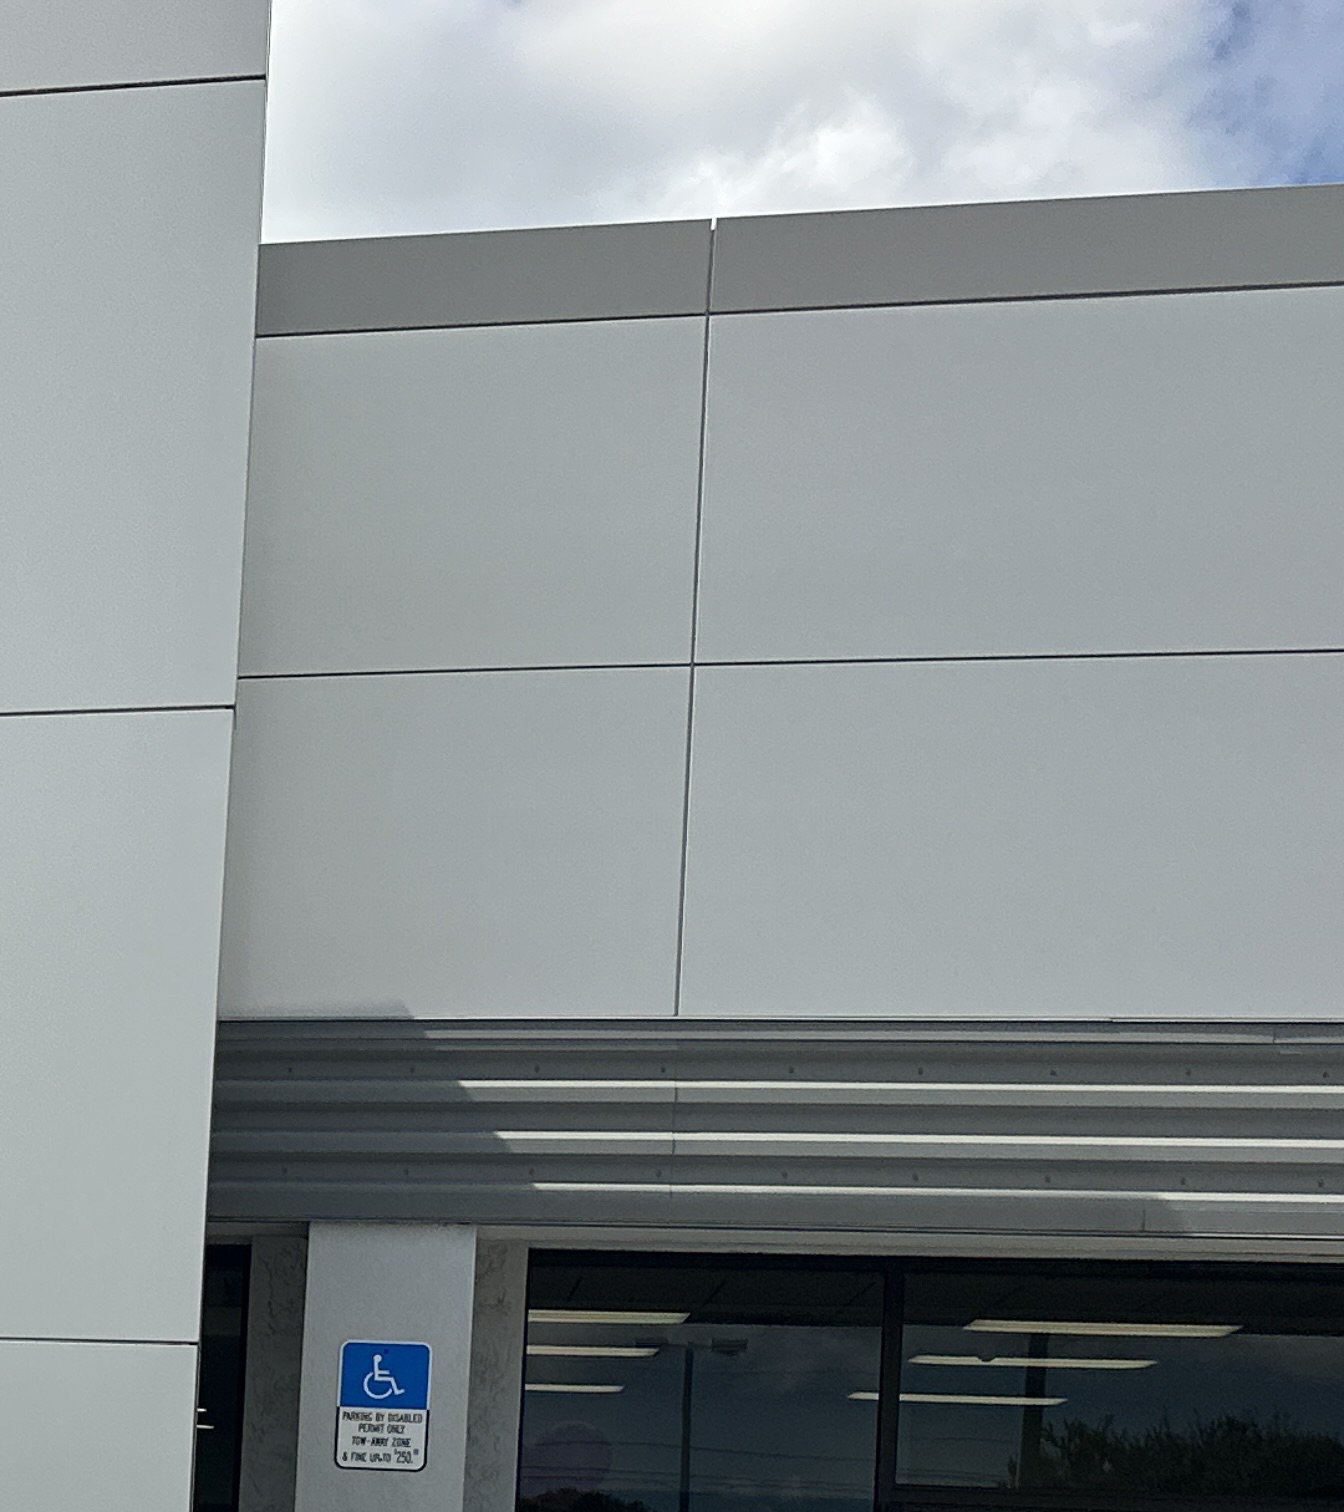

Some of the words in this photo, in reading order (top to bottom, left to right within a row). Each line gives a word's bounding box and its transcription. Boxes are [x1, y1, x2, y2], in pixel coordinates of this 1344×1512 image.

[342, 1411, 373, 1422] PARKING
[375, 1412, 385, 1422] BY
[388, 1413, 422, 1424] DISABLED
[358, 1423, 384, 1433] PERMIT
[387, 1424, 405, 1434] ONLY
[392, 1437, 411, 1447] ZONE
[350, 1452, 366, 1462] FINE
